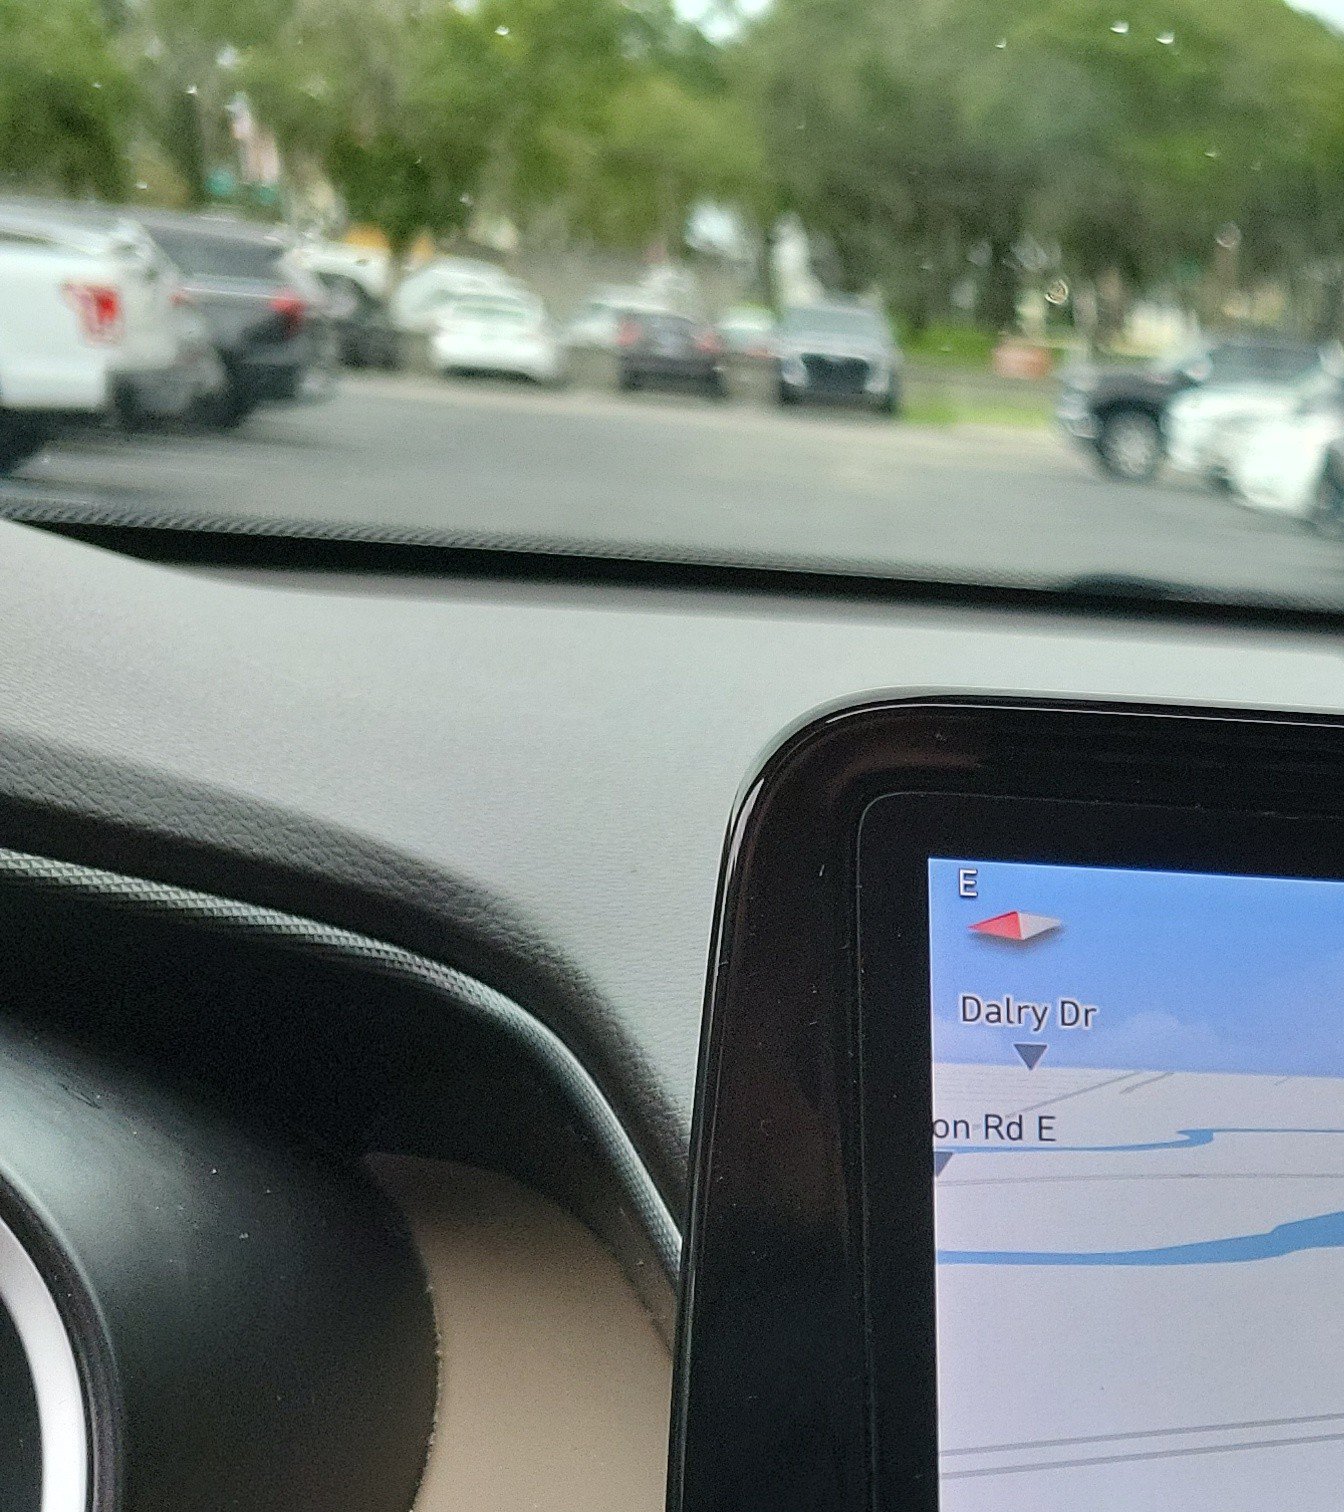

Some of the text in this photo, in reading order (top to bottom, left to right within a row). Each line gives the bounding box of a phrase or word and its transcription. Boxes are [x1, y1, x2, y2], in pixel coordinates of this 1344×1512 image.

[957, 868, 979, 898] E
[960, 996, 1098, 1030] Dalry Dr
[983, 1113, 1024, 1142] Rd
[1037, 1115, 1057, 1142] E
